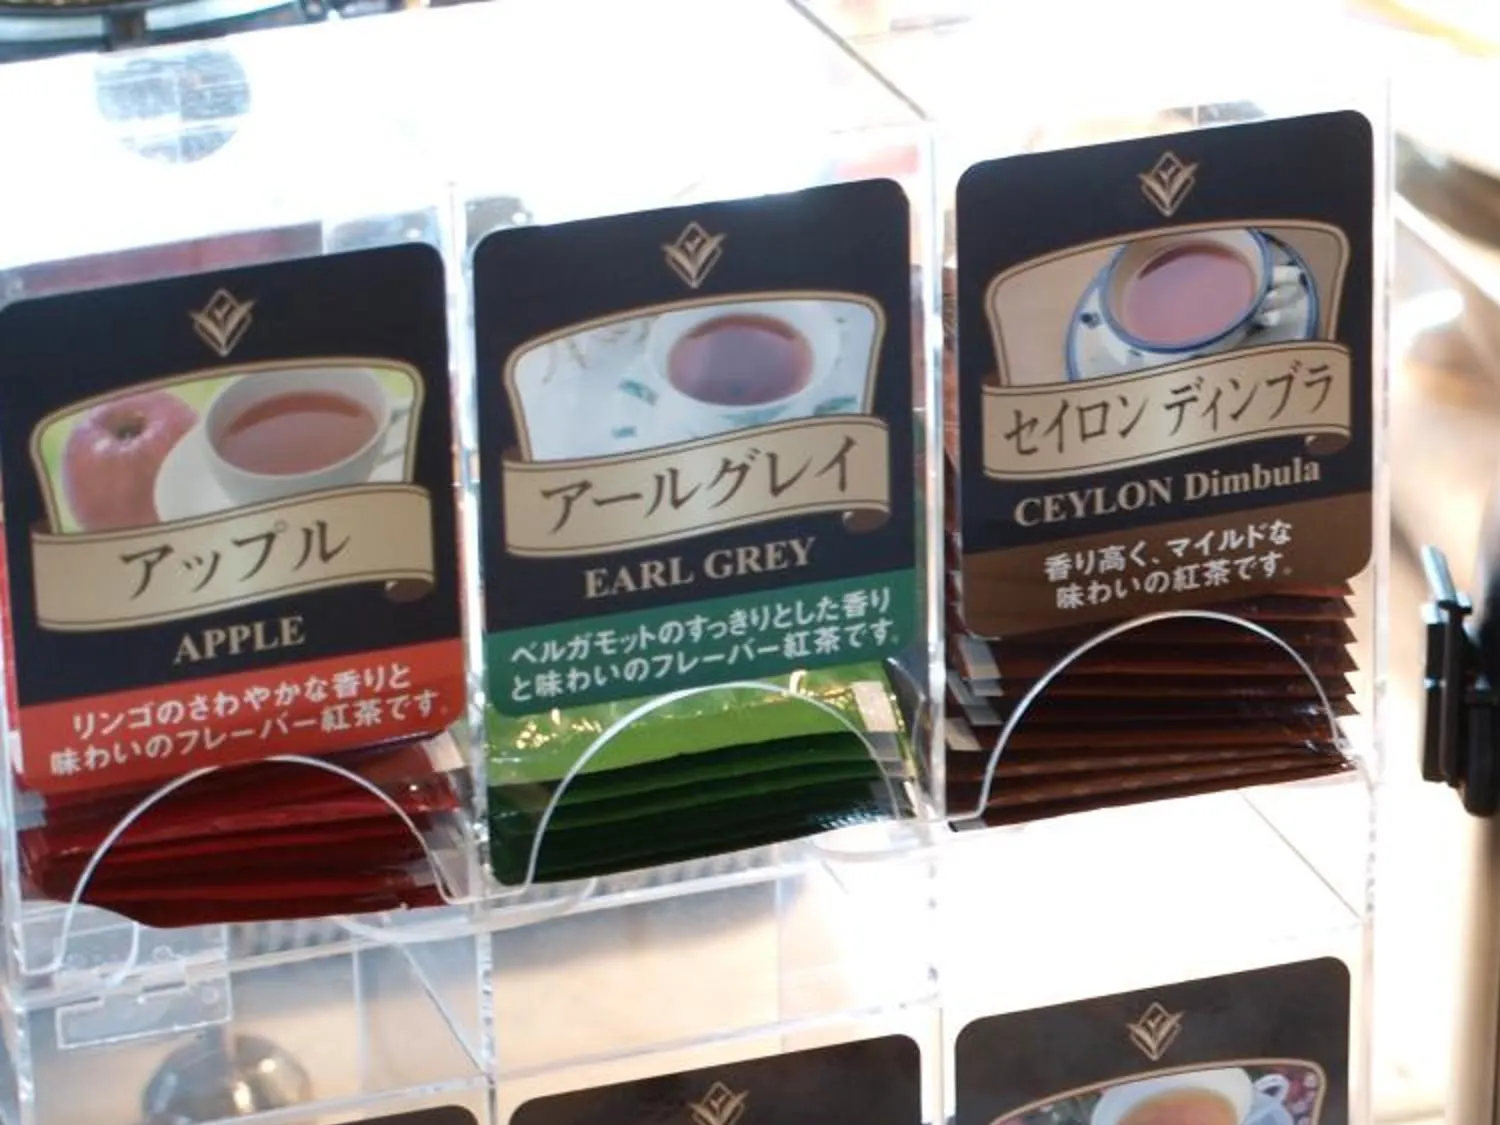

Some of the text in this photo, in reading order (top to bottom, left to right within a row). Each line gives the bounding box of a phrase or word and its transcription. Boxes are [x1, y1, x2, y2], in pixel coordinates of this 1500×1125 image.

[1004, 361, 1334, 456] セイロン ディンブラ
[541, 435, 858, 535] アールグレイ
[1013, 455, 1321, 528] CEYLON Dimbula
[119, 519, 350, 598] アップル
[584, 535, 815, 600] EARL GREY
[1043, 518, 1291, 581] 香り高く、マイルドな
[173, 615, 305, 665] APPLE
[72, 662, 410, 740] リンゴのさわやかな香りと
